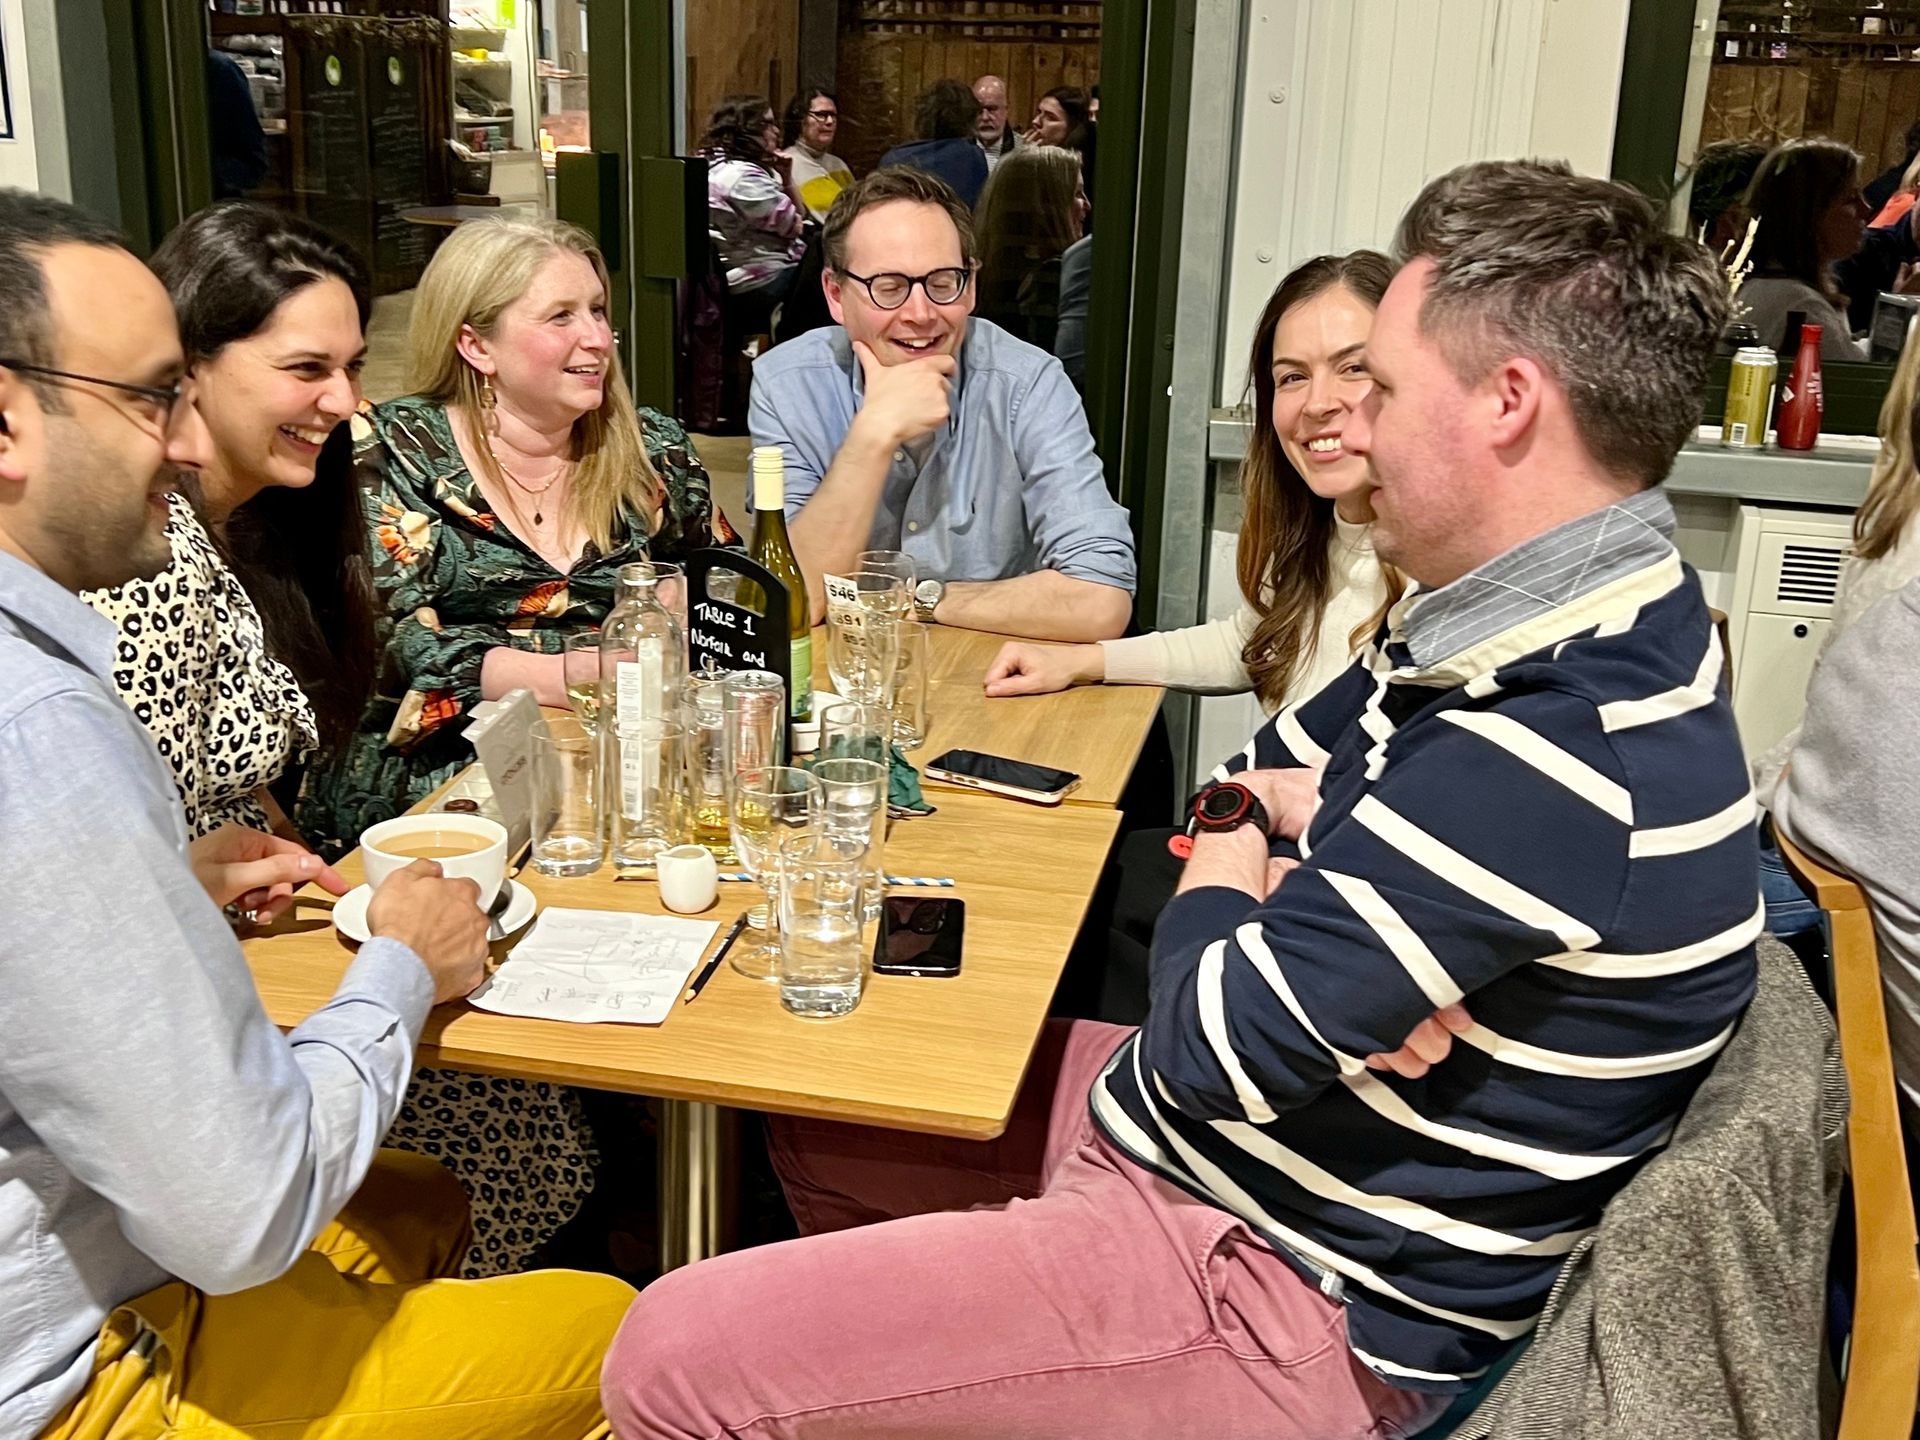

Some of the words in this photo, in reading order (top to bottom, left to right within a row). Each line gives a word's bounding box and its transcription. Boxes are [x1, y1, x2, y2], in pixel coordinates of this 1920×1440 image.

[743, 615, 756, 636] 1
[691, 627, 734, 658] Norfolk
[742, 650, 766, 668] and
